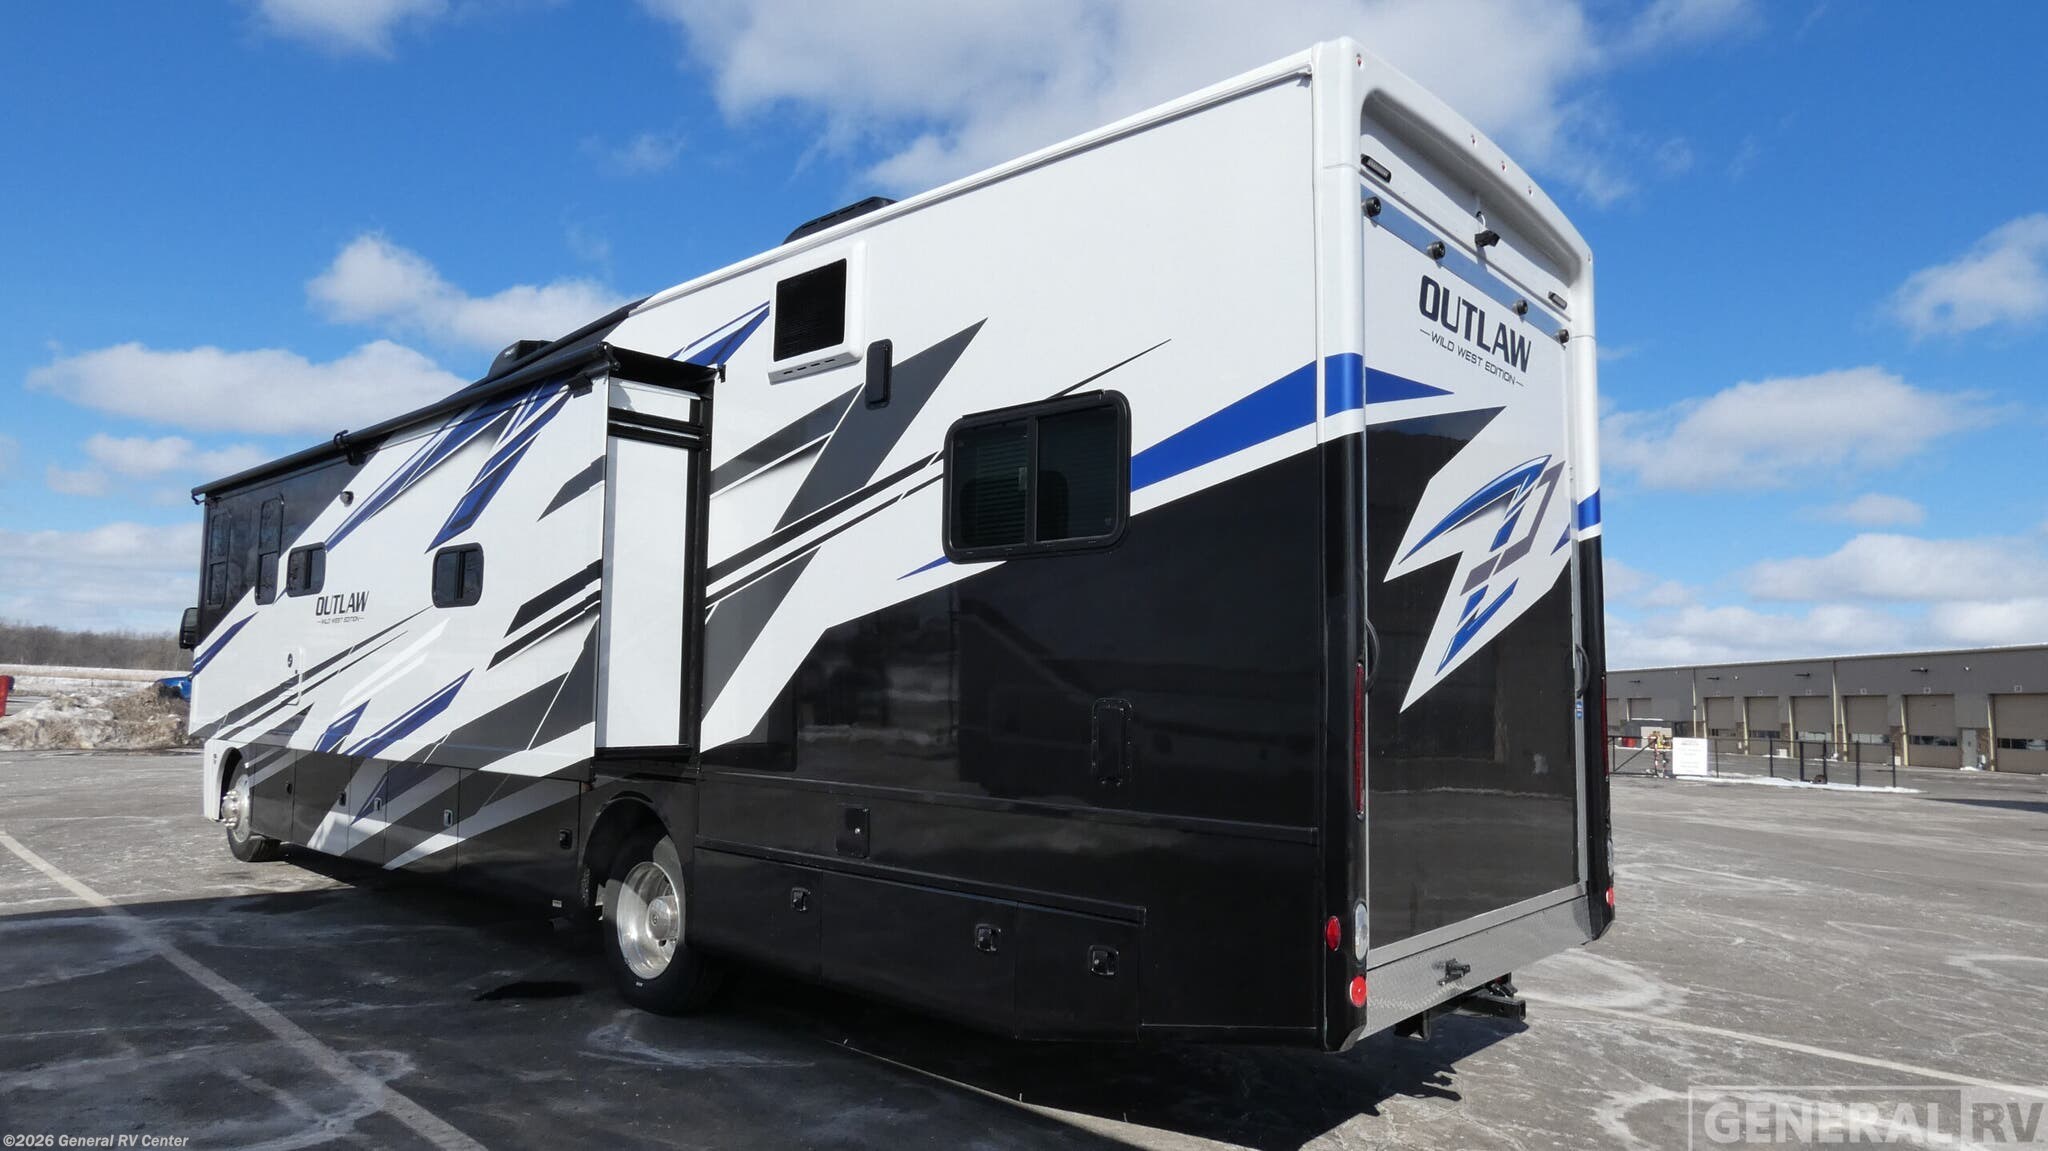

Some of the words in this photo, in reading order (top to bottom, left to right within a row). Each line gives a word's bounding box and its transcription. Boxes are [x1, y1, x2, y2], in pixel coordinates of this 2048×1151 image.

[1419, 275, 1532, 373] OUTLAW
[1431, 331, 1455, 352] WILD
[1457, 345, 1483, 367] WEST
[1484, 360, 1516, 385] EDITION
[315, 590, 370, 616] OUTLAW
